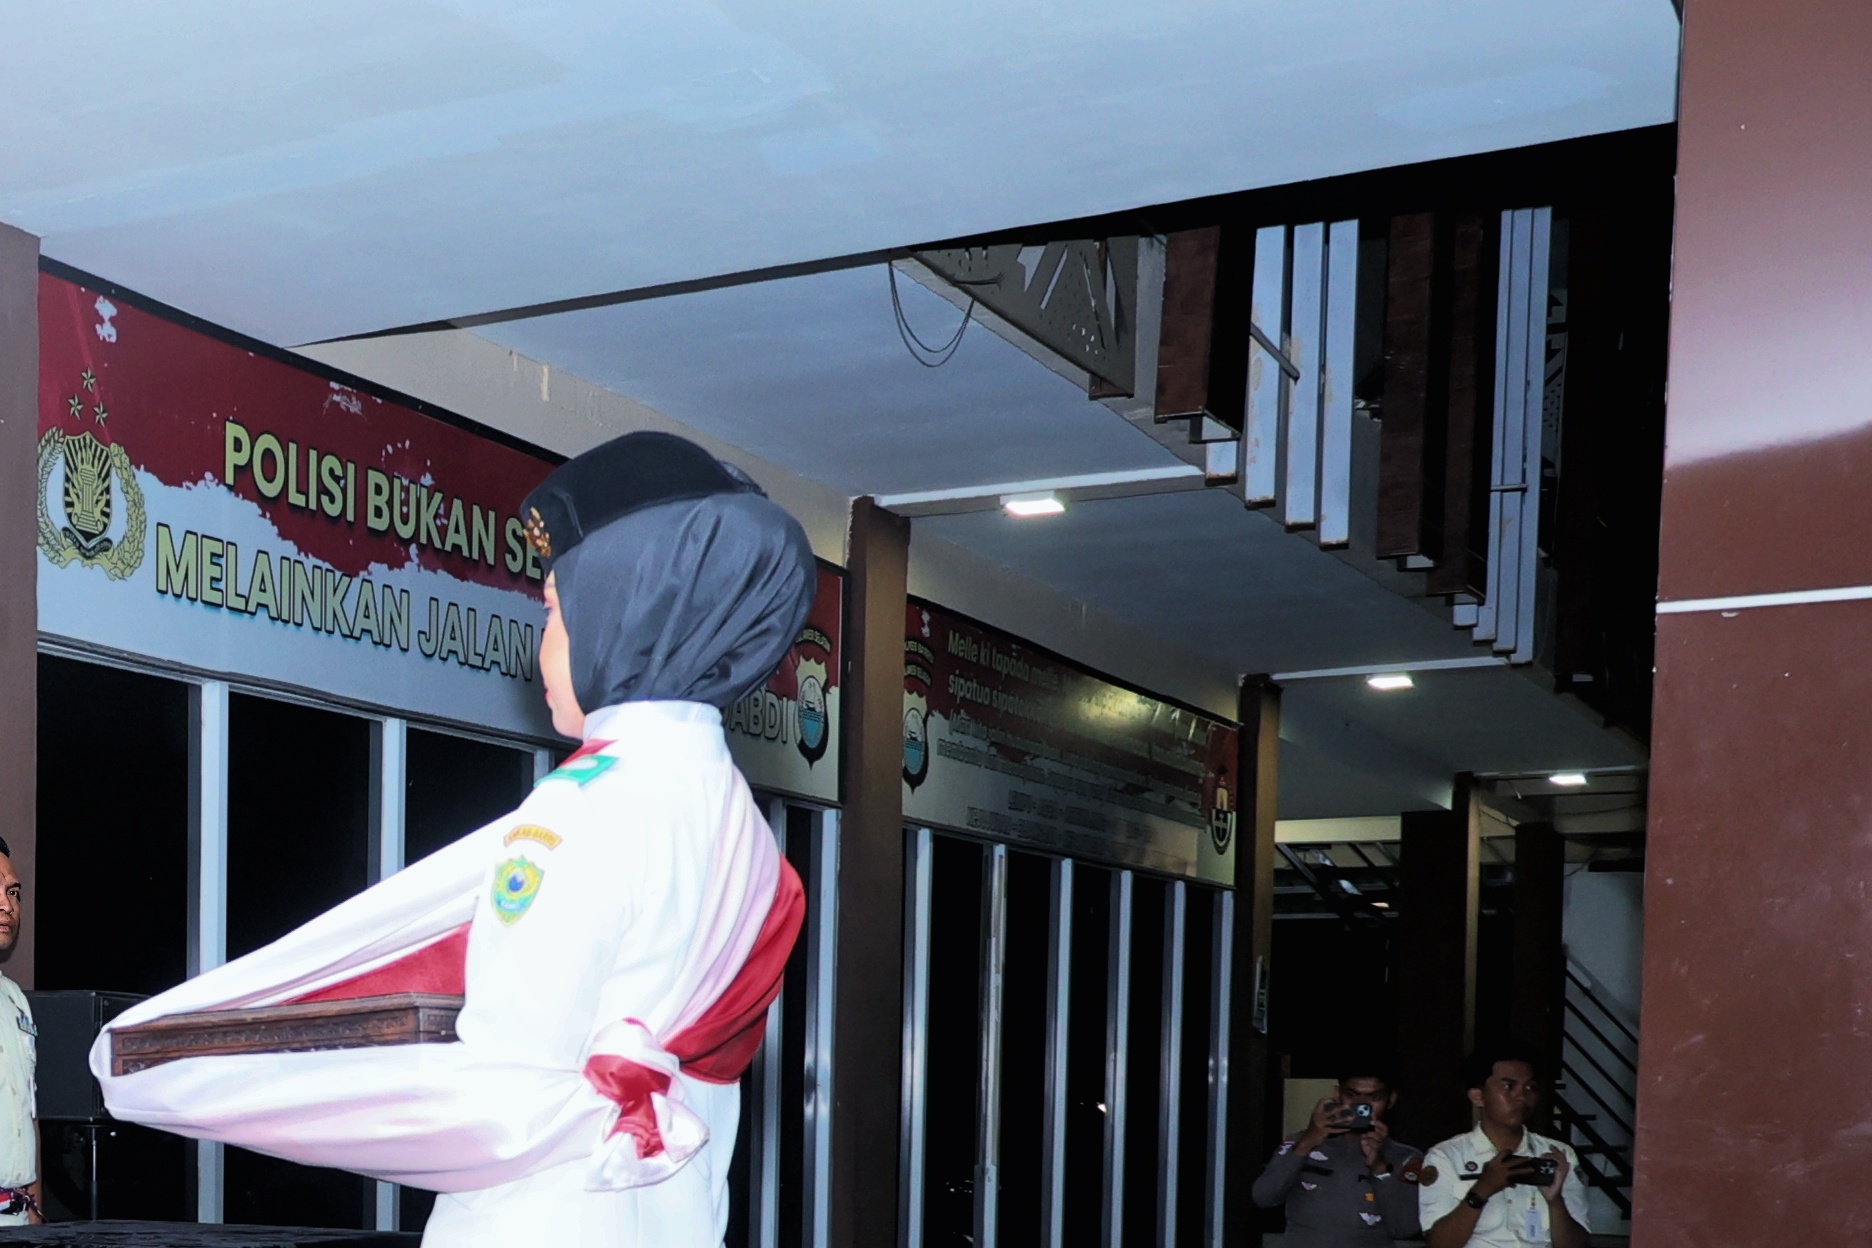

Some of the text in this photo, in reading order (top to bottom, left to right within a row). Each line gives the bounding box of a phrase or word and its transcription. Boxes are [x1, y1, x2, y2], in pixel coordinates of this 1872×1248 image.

[224, 419, 357, 524] POLISI
[366, 469, 496, 566] BUKAN
[155, 523, 534, 681] MELAINKAN JALAN
[729, 687, 789, 744] ABDI
